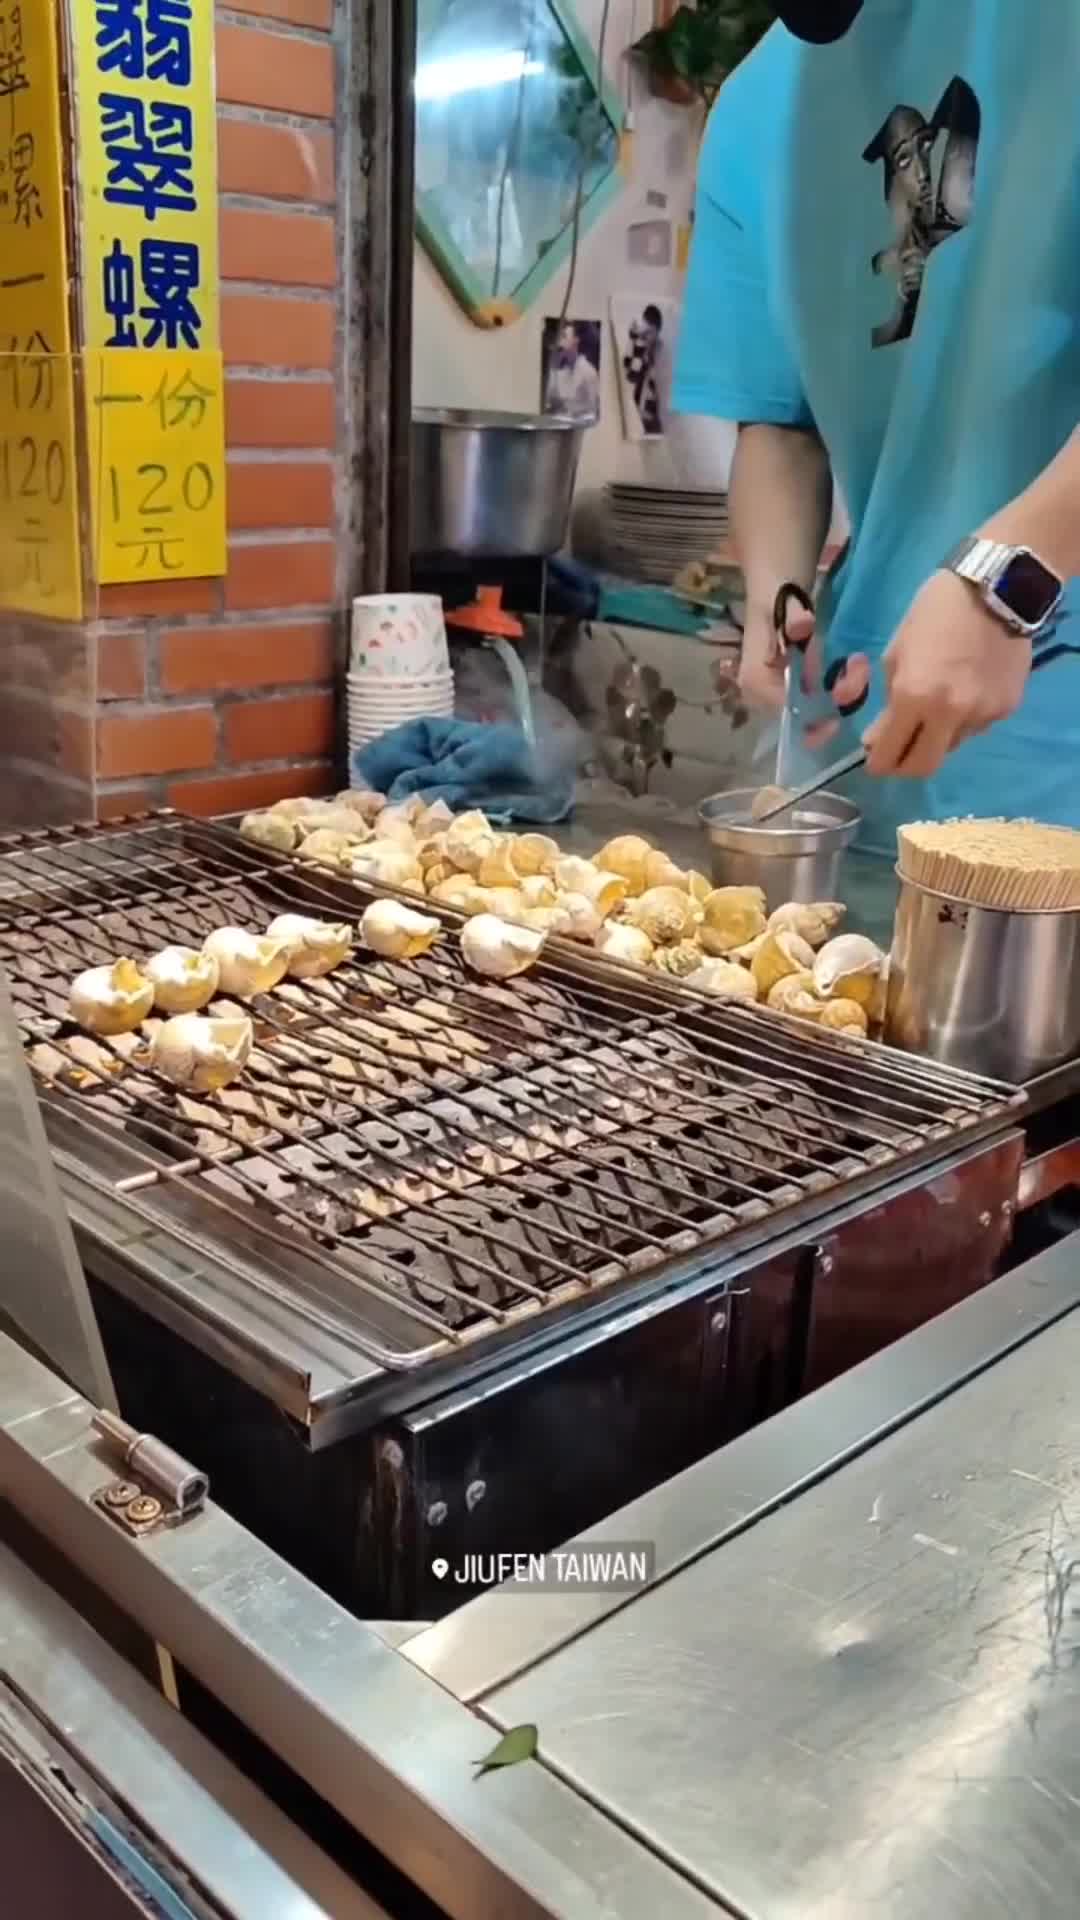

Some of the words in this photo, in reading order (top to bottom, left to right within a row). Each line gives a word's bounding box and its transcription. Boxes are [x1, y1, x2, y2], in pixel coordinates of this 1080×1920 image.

[95, 0, 201, 349] 翡翠螺
[93, 367, 217, 431] 一份
[2, 436, 66, 506] 120
[109, 461, 214, 524] 120
[115, 526, 186, 570] 元
